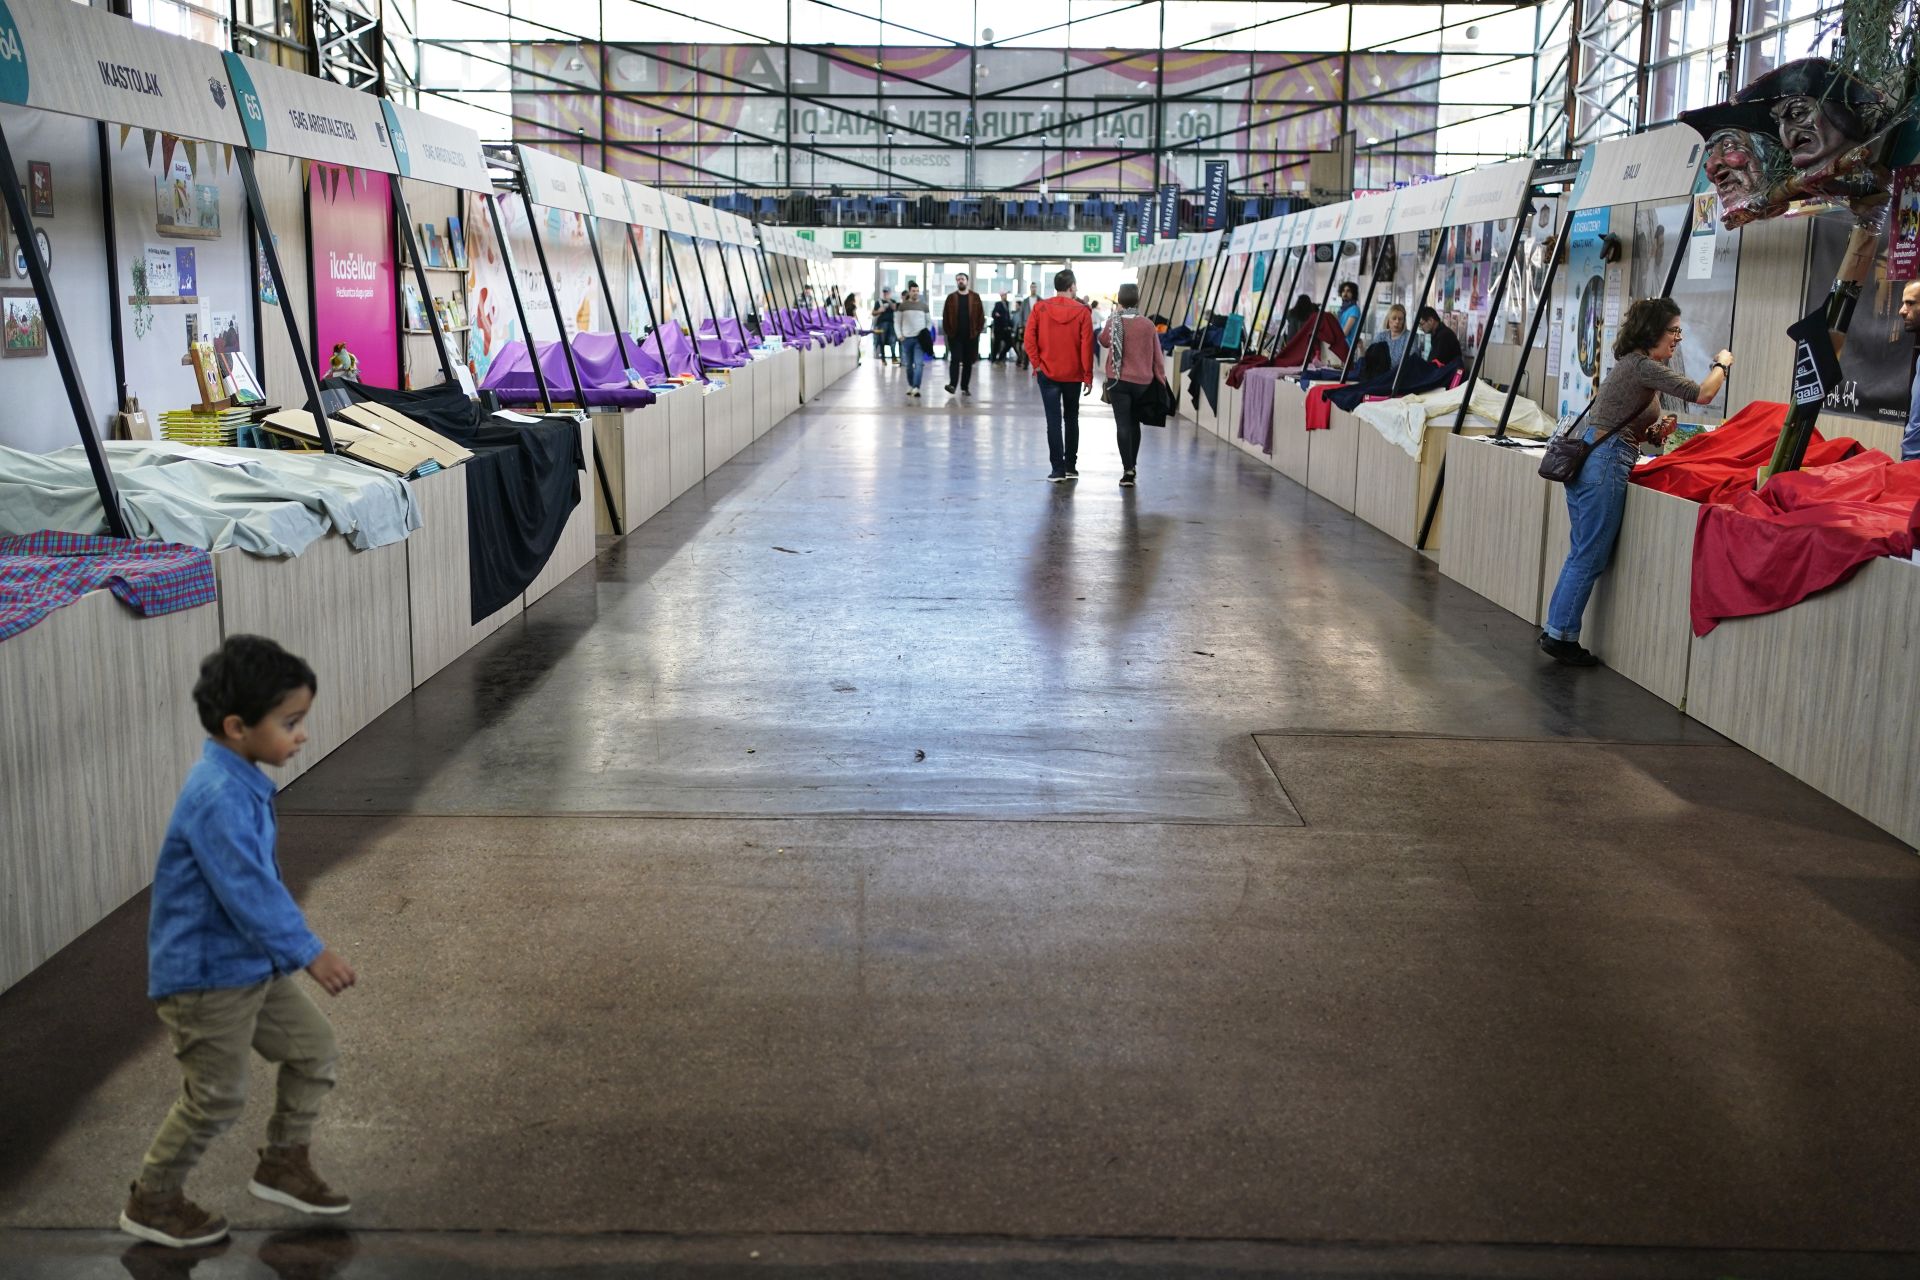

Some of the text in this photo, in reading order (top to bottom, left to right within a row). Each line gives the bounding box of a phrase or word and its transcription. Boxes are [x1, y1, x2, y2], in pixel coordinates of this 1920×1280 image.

[97, 60, 163, 97] IKASTOLAK
[244, 94, 262, 121] 65
[288, 109, 358, 141] 1545 ARGITALETXEA
[1622, 162, 1642, 181] BALU
[1208, 164, 1225, 217] IBAIZABAL
[1163, 185, 1177, 231] IBAIZABAL
